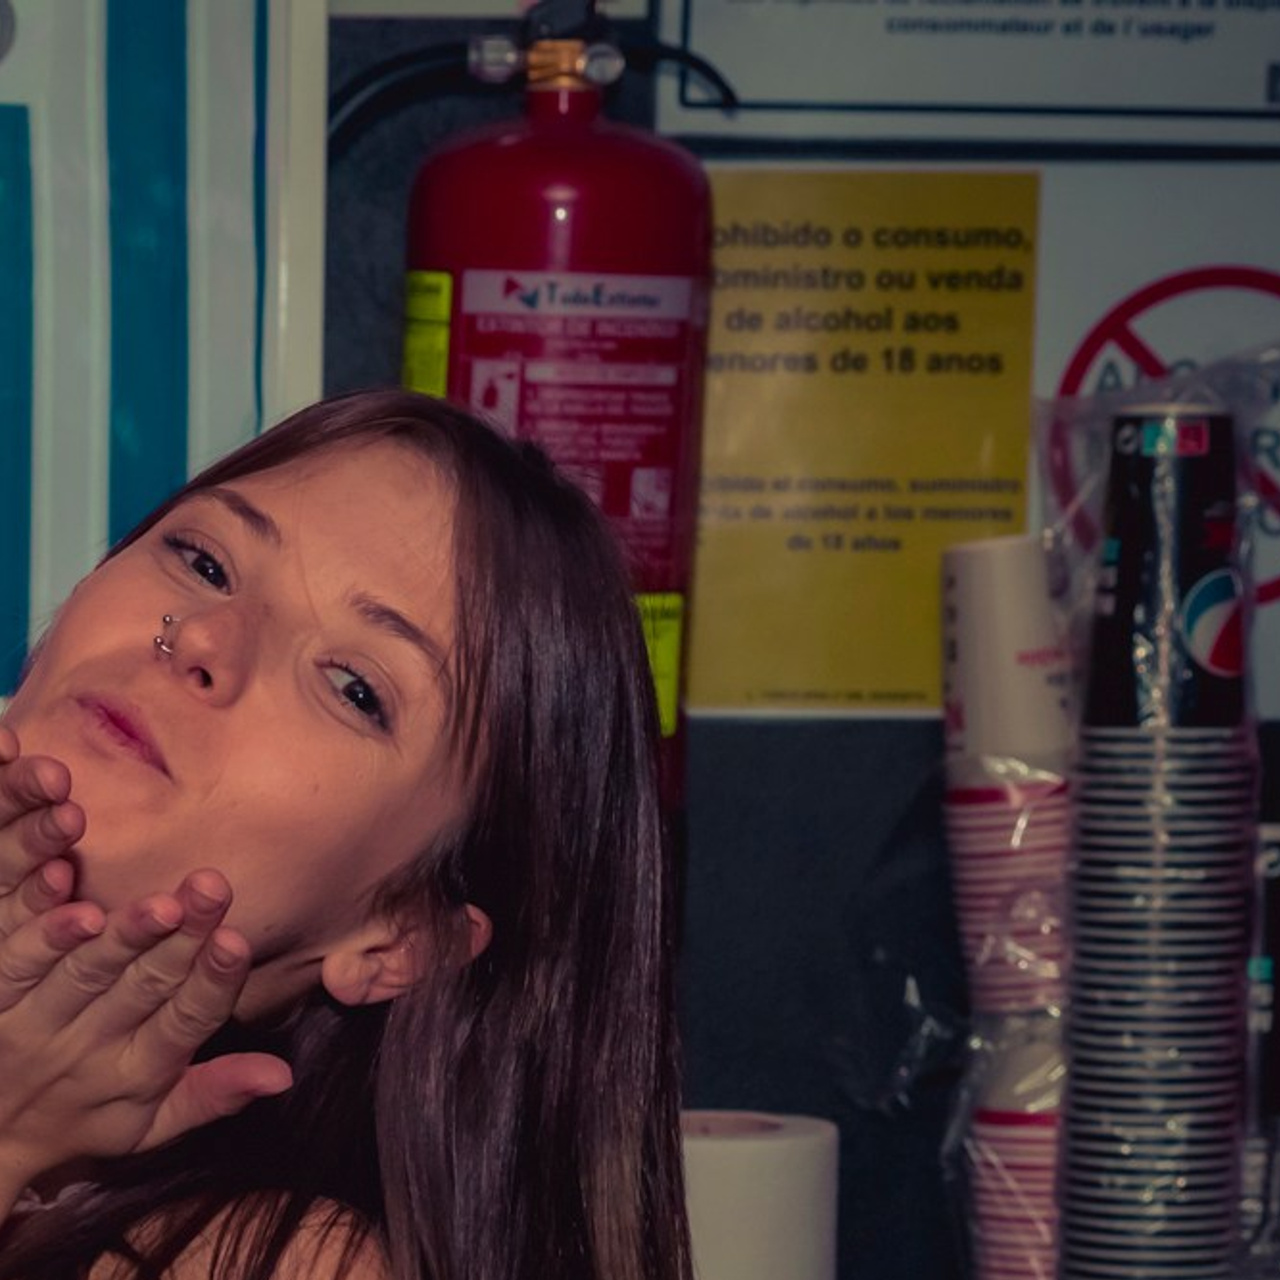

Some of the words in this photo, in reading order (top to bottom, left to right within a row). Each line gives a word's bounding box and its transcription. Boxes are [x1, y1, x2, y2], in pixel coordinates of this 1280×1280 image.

[711, 220, 832, 249] ohibido
[843, 227, 863, 248] o
[875, 269, 914, 290] ou
[927, 266, 1023, 291] venda
[726, 308, 762, 332] de
[774, 307, 892, 333] alcohol
[904, 312, 959, 333] aos
[706, 351, 818, 373] enores
[830, 347, 866, 373] de
[883, 347, 914, 372] 18
[926, 352, 1003, 374] anos
